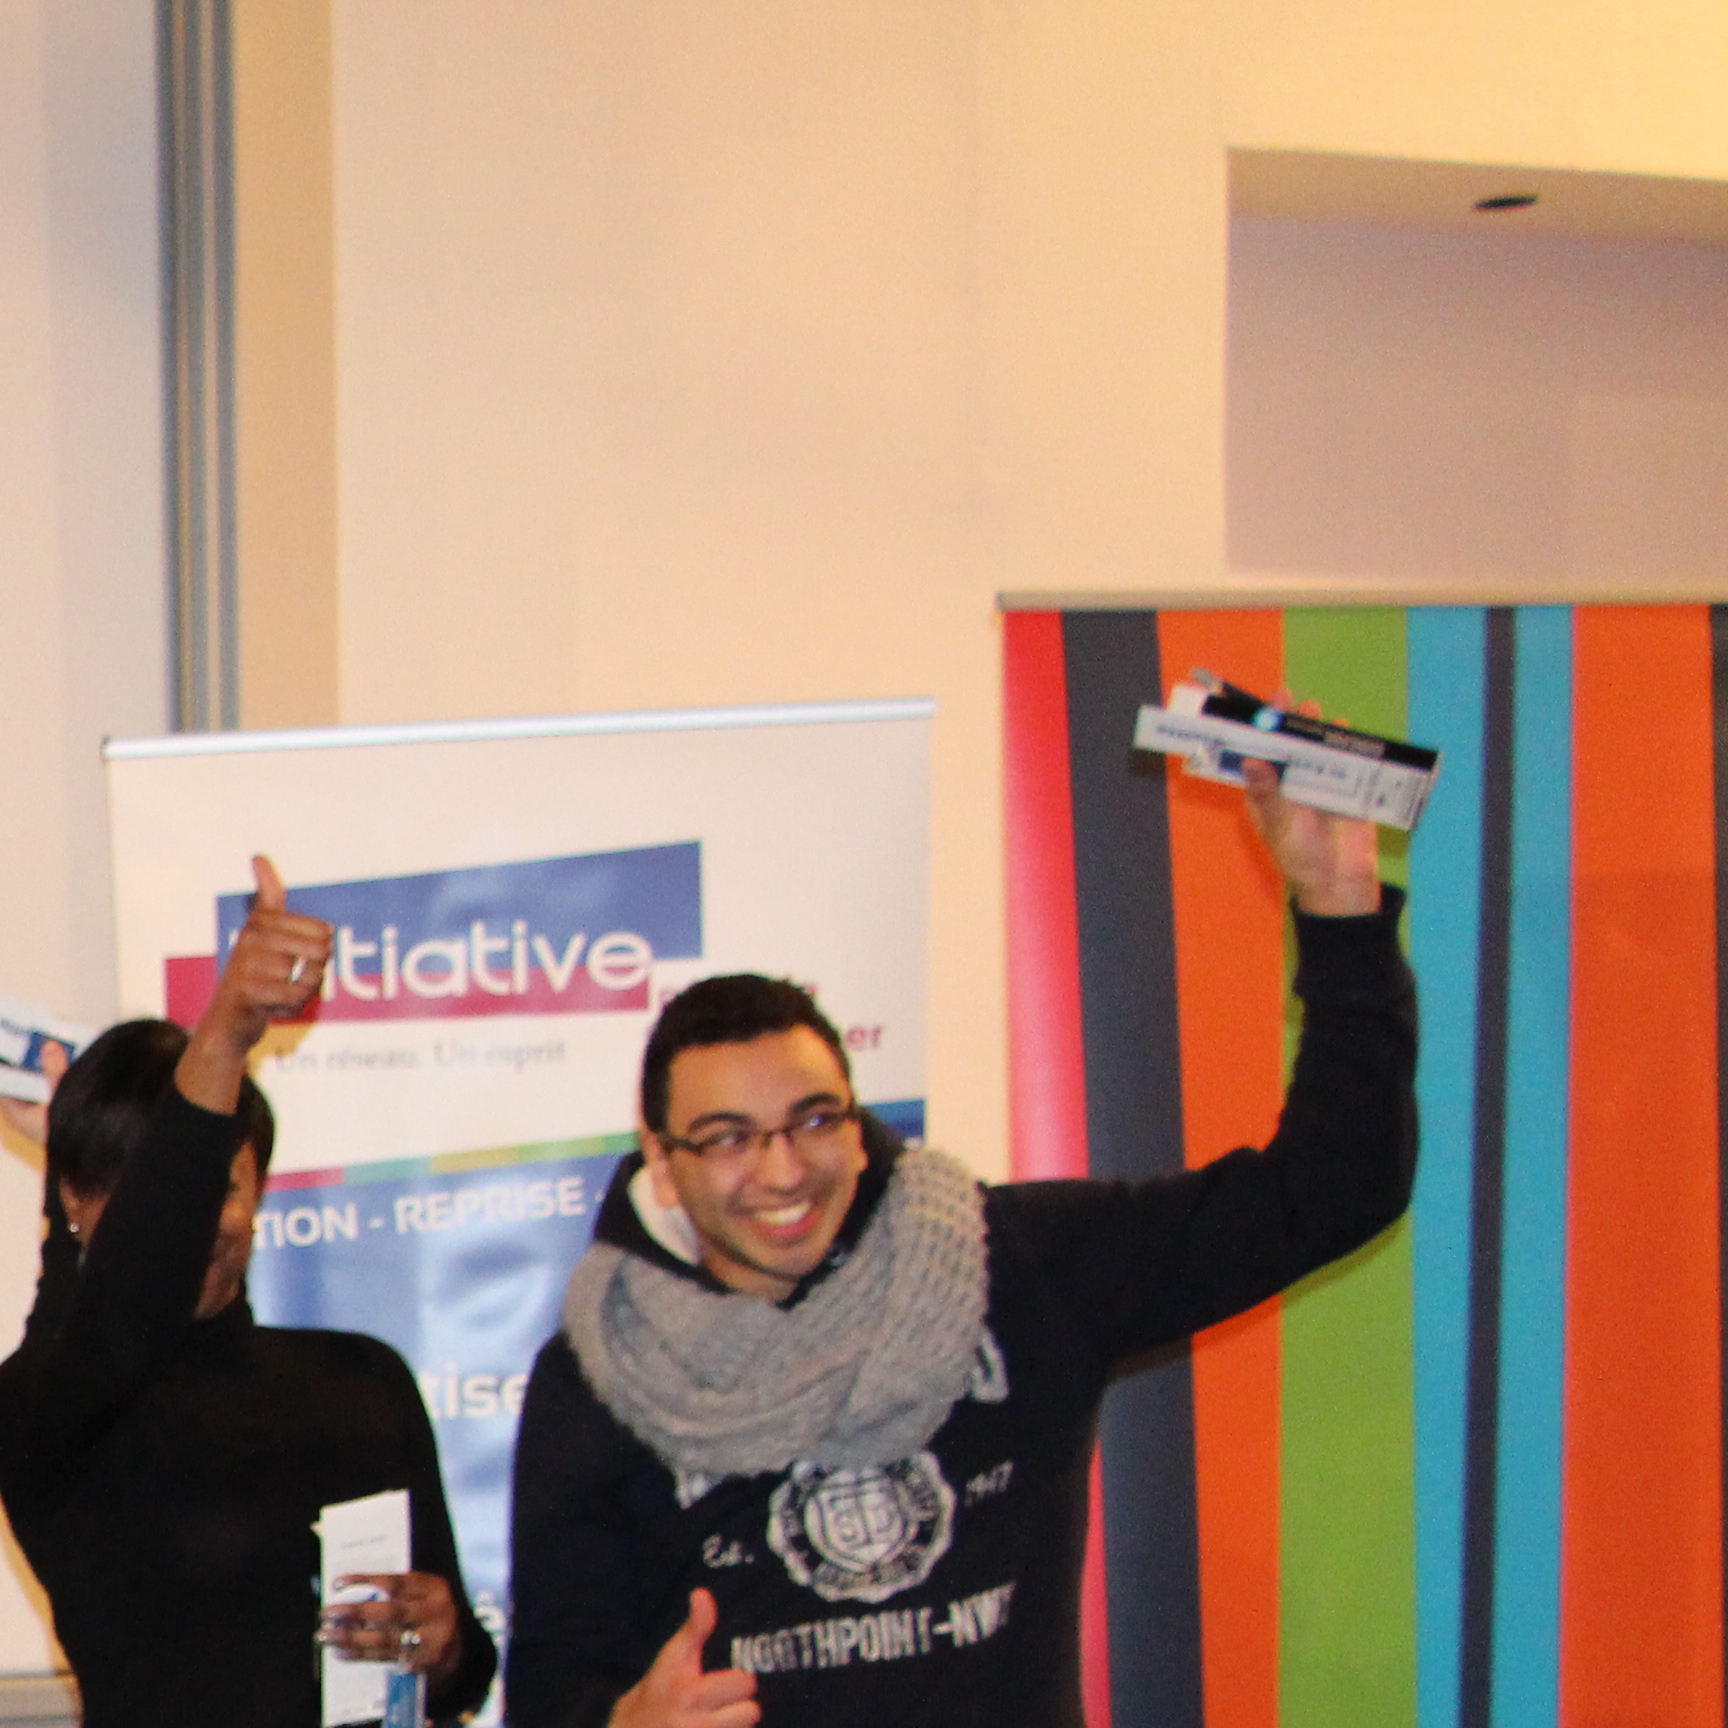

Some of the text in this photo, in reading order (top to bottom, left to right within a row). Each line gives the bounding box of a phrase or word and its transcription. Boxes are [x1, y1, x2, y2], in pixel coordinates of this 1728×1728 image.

[232, 920, 653, 1001] tiative
[253, 1203, 359, 1248] TION
[395, 1175, 587, 1235] REPRISE
